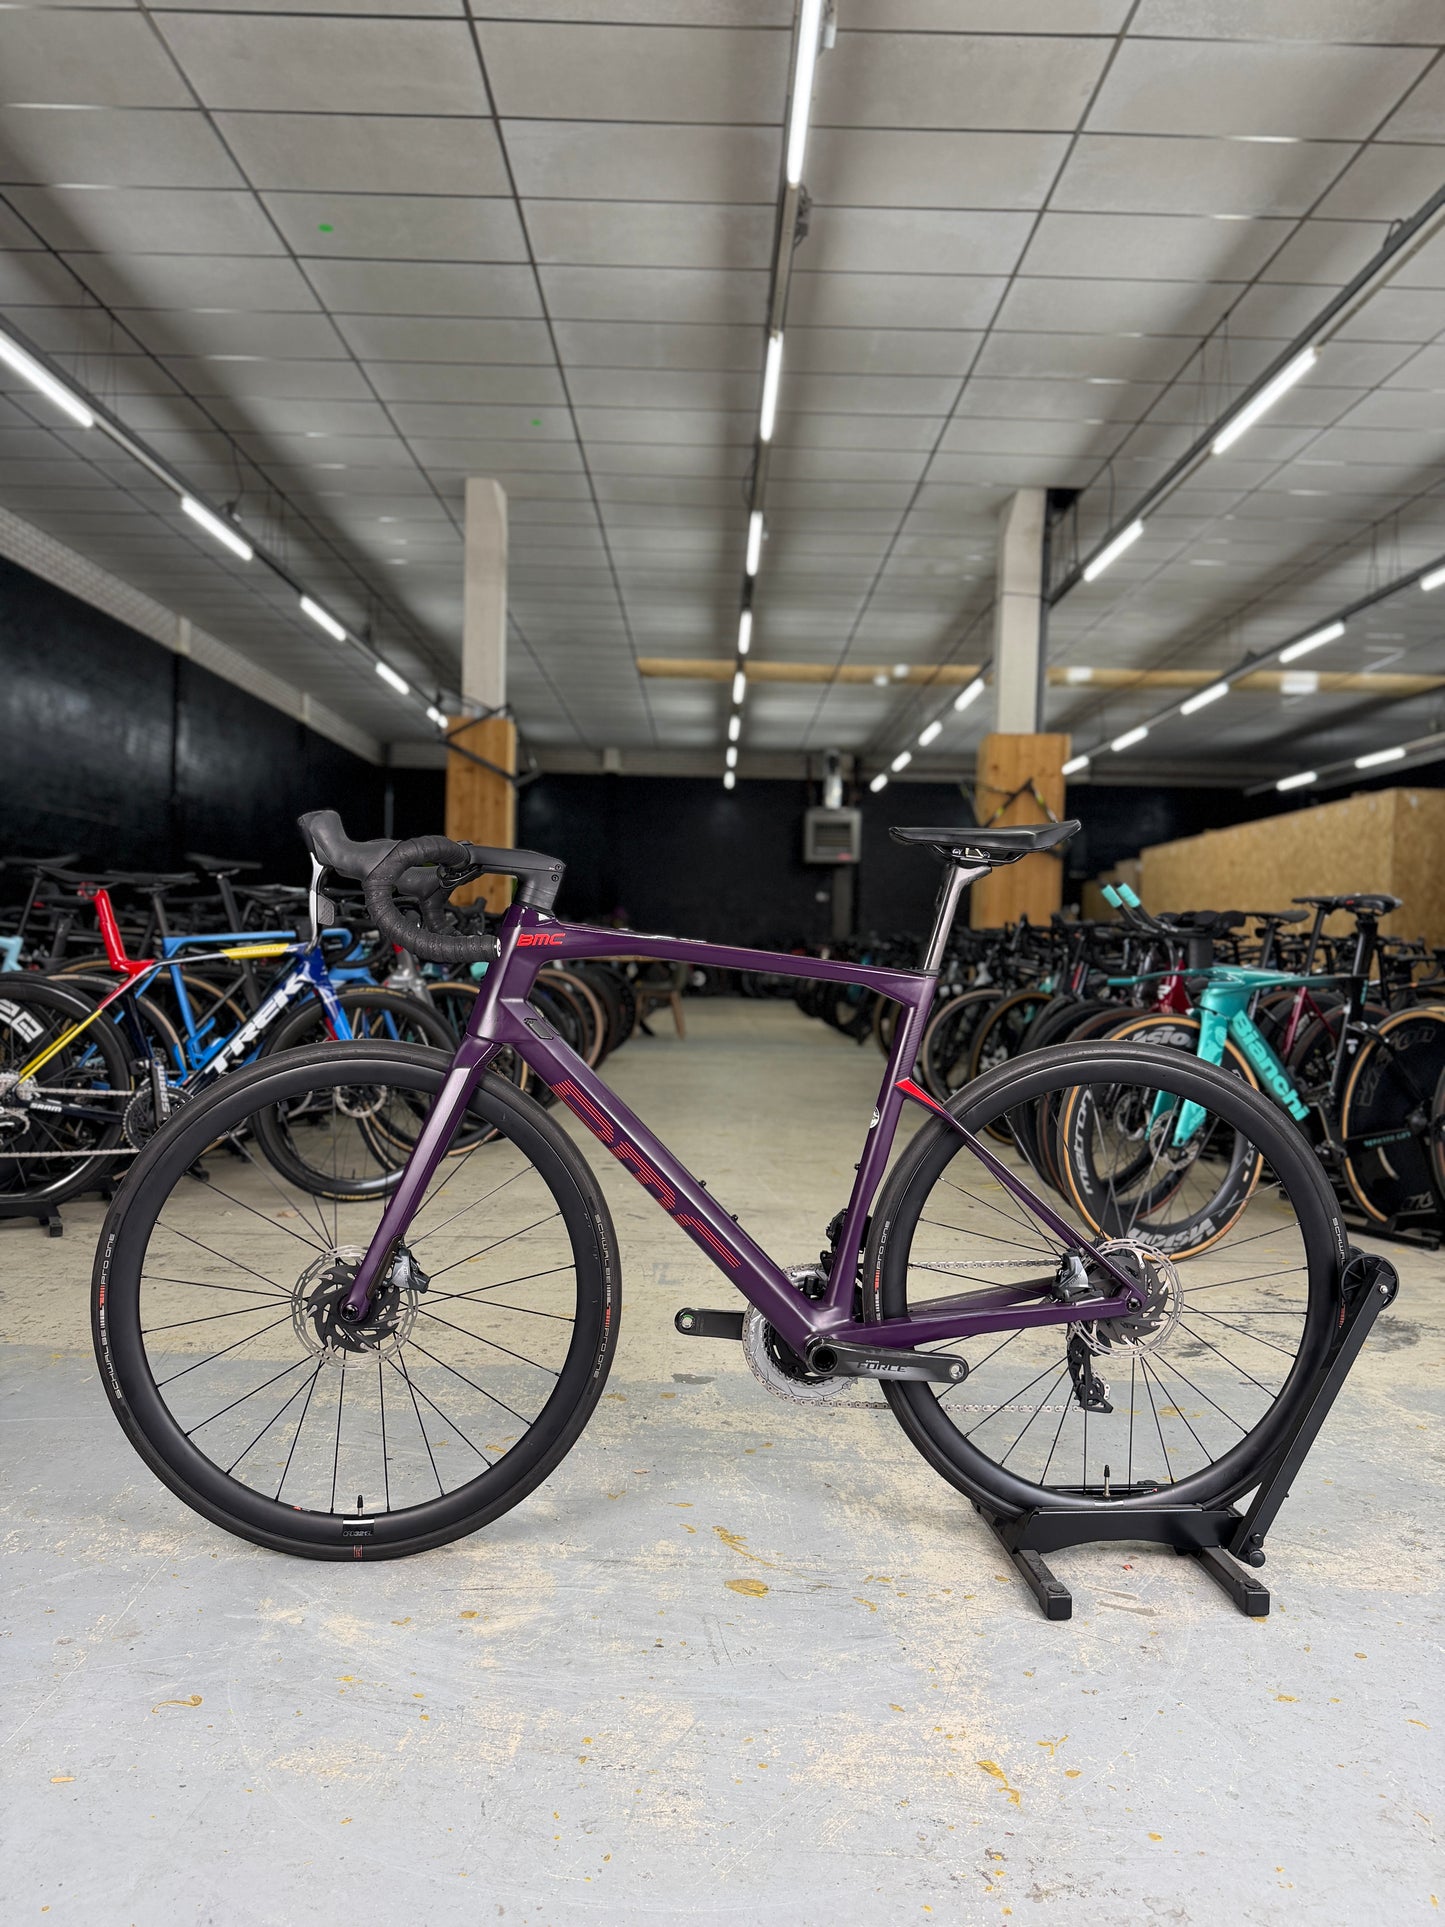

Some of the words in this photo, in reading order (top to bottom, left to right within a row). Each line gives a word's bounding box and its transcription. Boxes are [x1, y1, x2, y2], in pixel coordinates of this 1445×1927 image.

[517, 933, 566, 947] BMC
[204, 972, 304, 1074] TREK
[1232, 1009, 1311, 1122] Bianchi
[30, 1102, 63, 1113] SRAM
[594, 1213, 612, 1285] SCHWALBE
[1332, 1217, 1346, 1267] SCHWAL
[101, 1329, 123, 1400] SCHWALBE
[857, 1361, 907, 1373] FORCE
